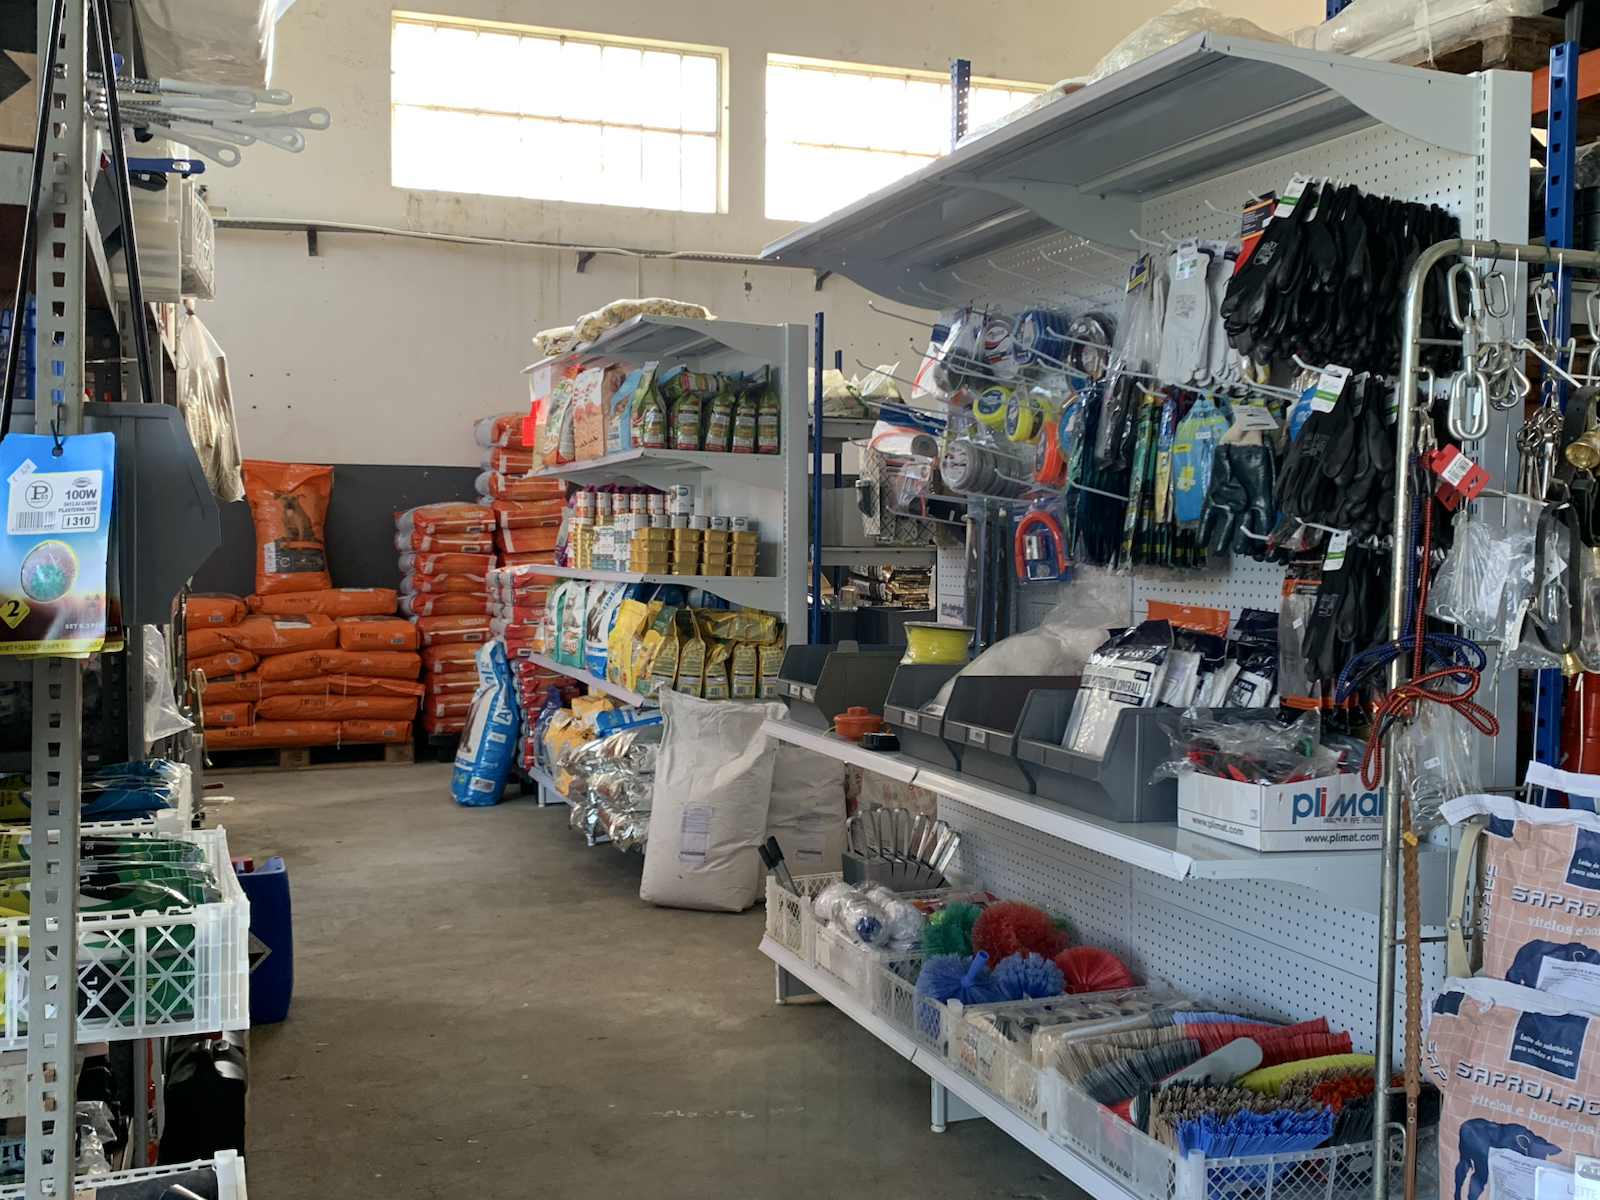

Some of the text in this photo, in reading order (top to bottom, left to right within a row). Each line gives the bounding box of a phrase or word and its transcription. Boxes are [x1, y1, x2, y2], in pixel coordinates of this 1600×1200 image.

[65, 489, 97, 500] 100W
[72, 516, 91, 526] 310
[7, 600, 20, 618] 2
[1192, 816, 1244, 836] www.plimat.com
[1362, 816, 1382, 824] FITTINGS
[1304, 833, 1379, 844] www.plimat.com
[1571, 867, 1586, 877] para
[1511, 885, 1600, 918] SAPRO
[1528, 916, 1573, 935] vitelos
[1575, 926, 1583, 936] e
[1520, 1033, 1535, 1044] Leite
[1534, 1039, 1543, 1048] de
[1514, 1044, 1527, 1052] para
[1527, 1046, 1546, 1059] vitelos
[1551, 1055, 1575, 1068] borregos
[1470, 1093, 1597, 1136] vitelos e borregos
